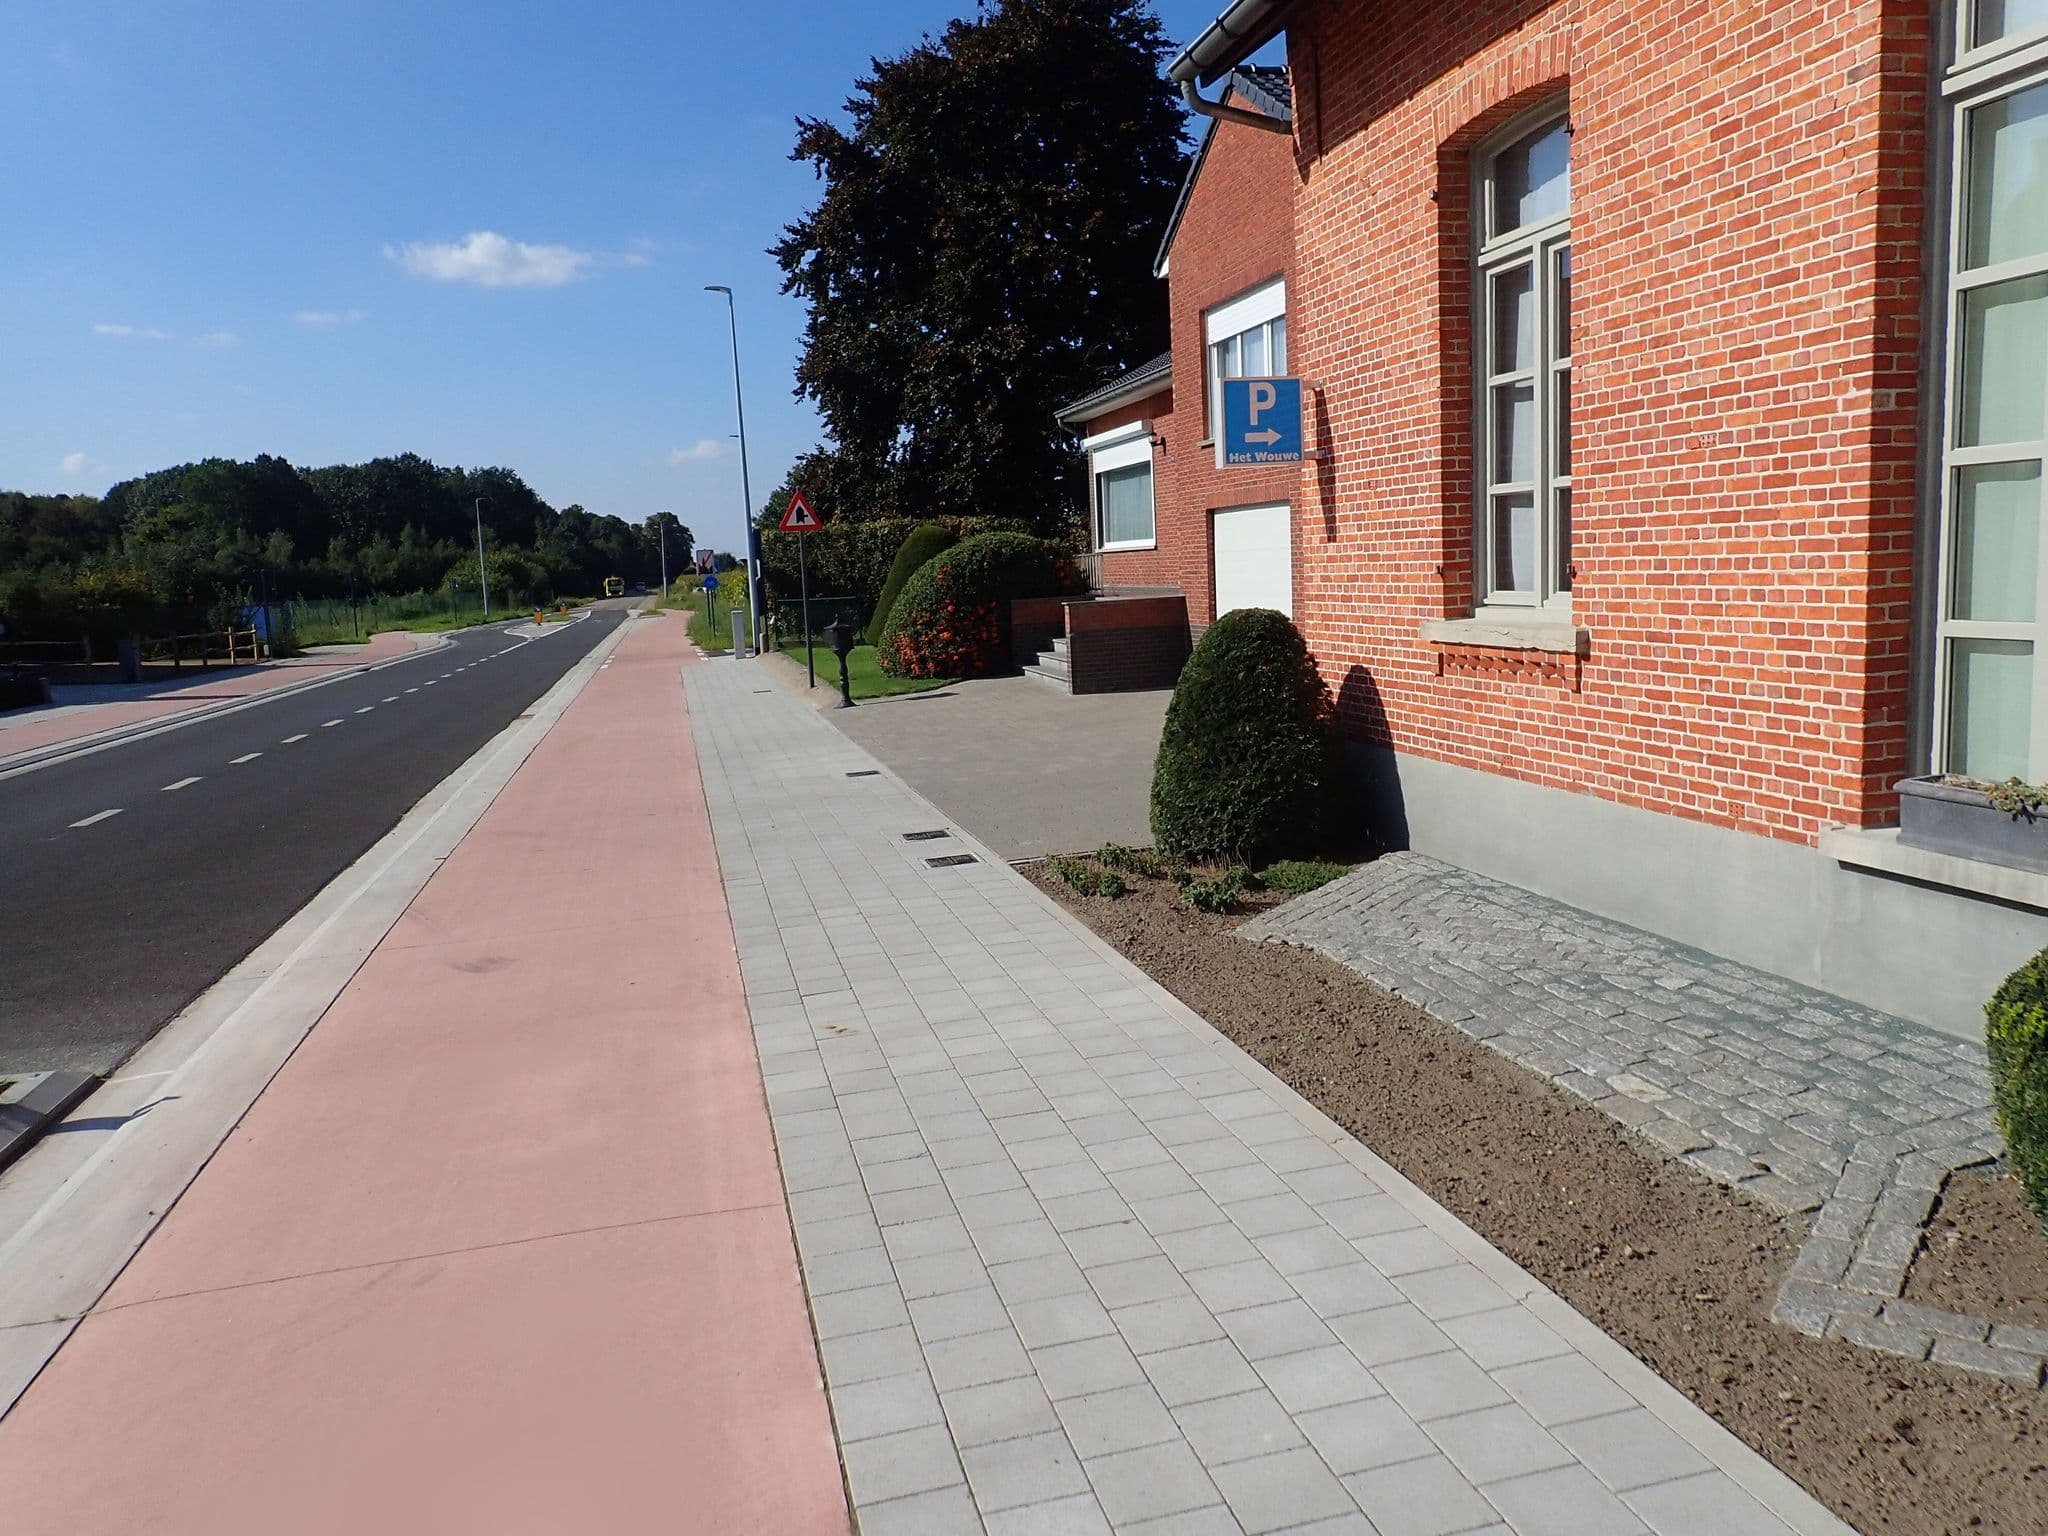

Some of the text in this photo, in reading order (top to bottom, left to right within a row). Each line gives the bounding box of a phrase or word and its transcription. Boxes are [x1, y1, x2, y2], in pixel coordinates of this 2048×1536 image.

[1249, 382, 1276, 426] P
[1229, 451, 1300, 463] Het Wouwe
